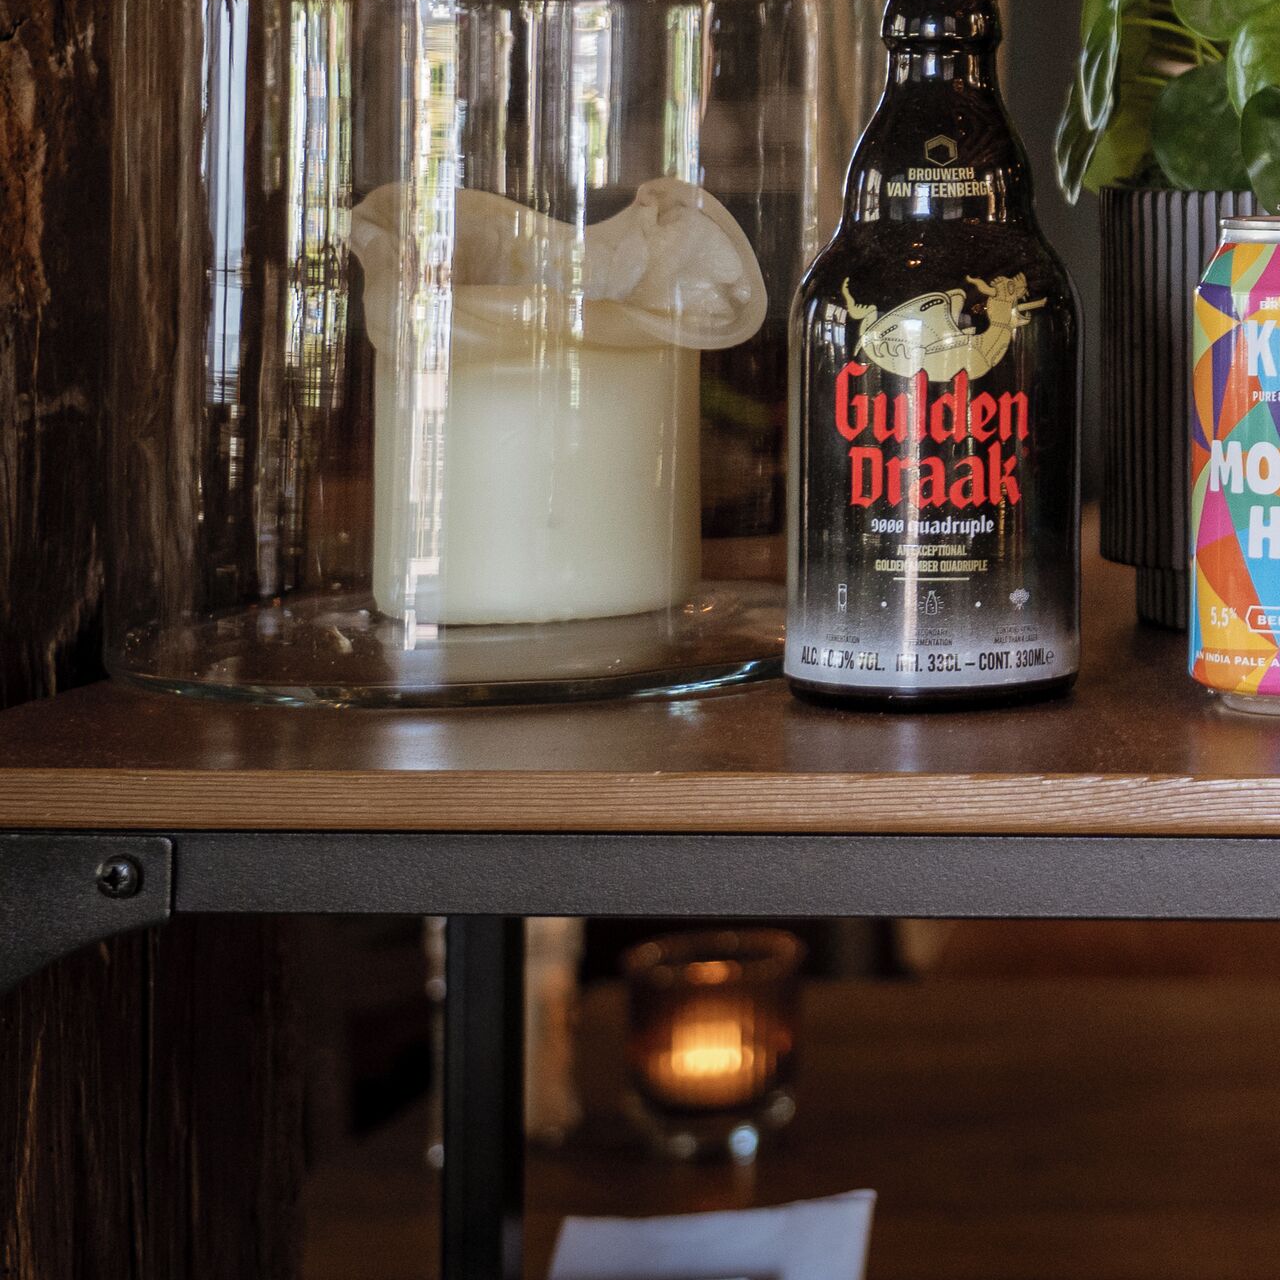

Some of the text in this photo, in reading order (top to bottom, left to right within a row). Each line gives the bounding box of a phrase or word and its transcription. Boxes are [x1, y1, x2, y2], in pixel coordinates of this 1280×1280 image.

[887, 182, 912, 197] VAN
[835, 360, 1029, 444] Gulden
[848, 440, 1022, 510] Draak
[912, 545, 967, 556] XCEPTIONAL
[910, 560, 939, 572] MBER
[940, 560, 988, 572] QUADRUPLE
[801, 646, 820, 667] ALC.
[927, 653, 962, 672] 33CL
[978, 651, 1013, 671] CONT.
[1206, 651, 1231, 665] INDIA
[1234, 655, 1266, 667] PALE
